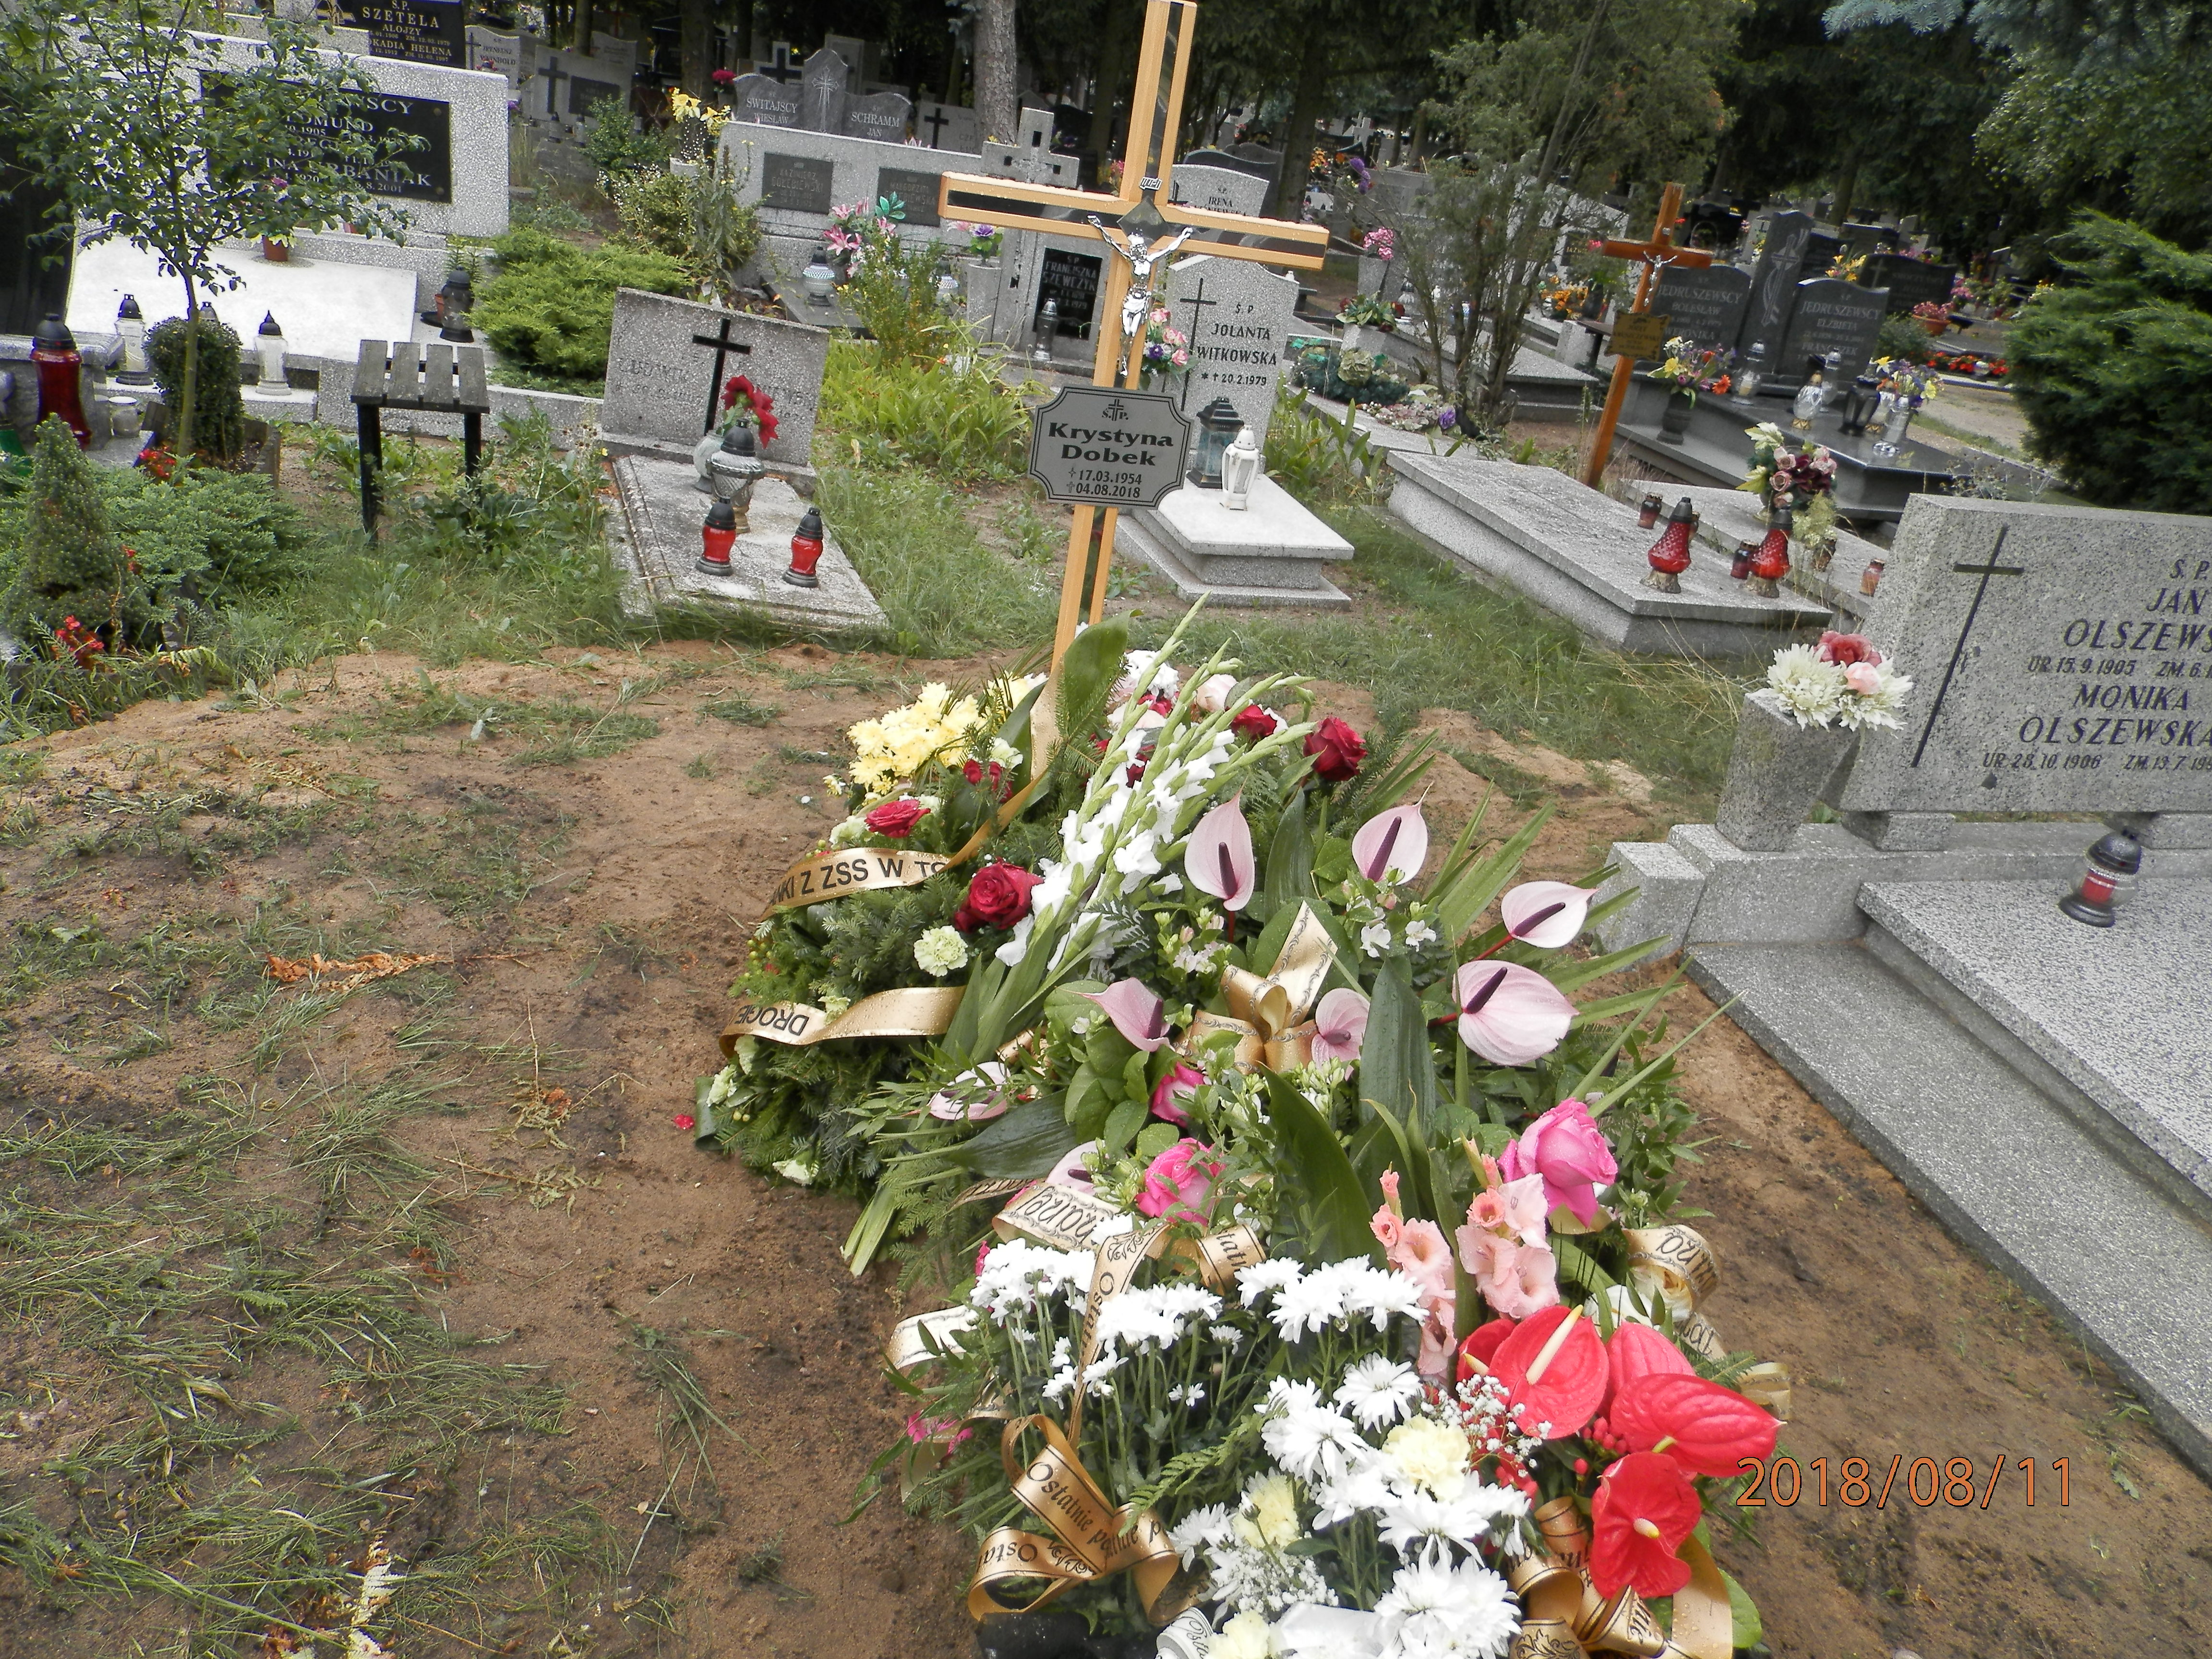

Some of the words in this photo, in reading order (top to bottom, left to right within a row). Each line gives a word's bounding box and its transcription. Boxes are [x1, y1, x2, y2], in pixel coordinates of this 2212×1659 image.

[362, 7, 439, 28] SZETELA
[383, 24, 421, 35] ALOJZY
[411, 44, 452, 56] HELENA
[852, 112, 900, 127] SCHRAMM
[867, 127, 882, 137] JAN
[1209, 196, 1233, 207] IRENA
[1046, 261, 1096, 278] FRANCISZKA
[1042, 271, 1095, 291] SZEWCZYK
[1211, 323, 1270, 340] JOLANTA
[1198, 346, 1277, 366] WITKOWSKA
[1048, 422, 1174, 447] Krystyna
[1061, 445, 1155, 466] Dobek
[1079, 469, 1142, 484] 17.03.1954
[1076, 482, 1141, 498] 04.08.2018
[2146, 588, 2209, 614] JAN
[2072, 684, 2189, 710] MONIKA
[2019, 717, 2212, 746] OLSZEWSKA
[800, 870, 815, 895] Z
[820, 858, 869, 890] ZSS
[878, 857, 904, 878] W
[1026, 1462, 1094, 1532] Ostatnie
